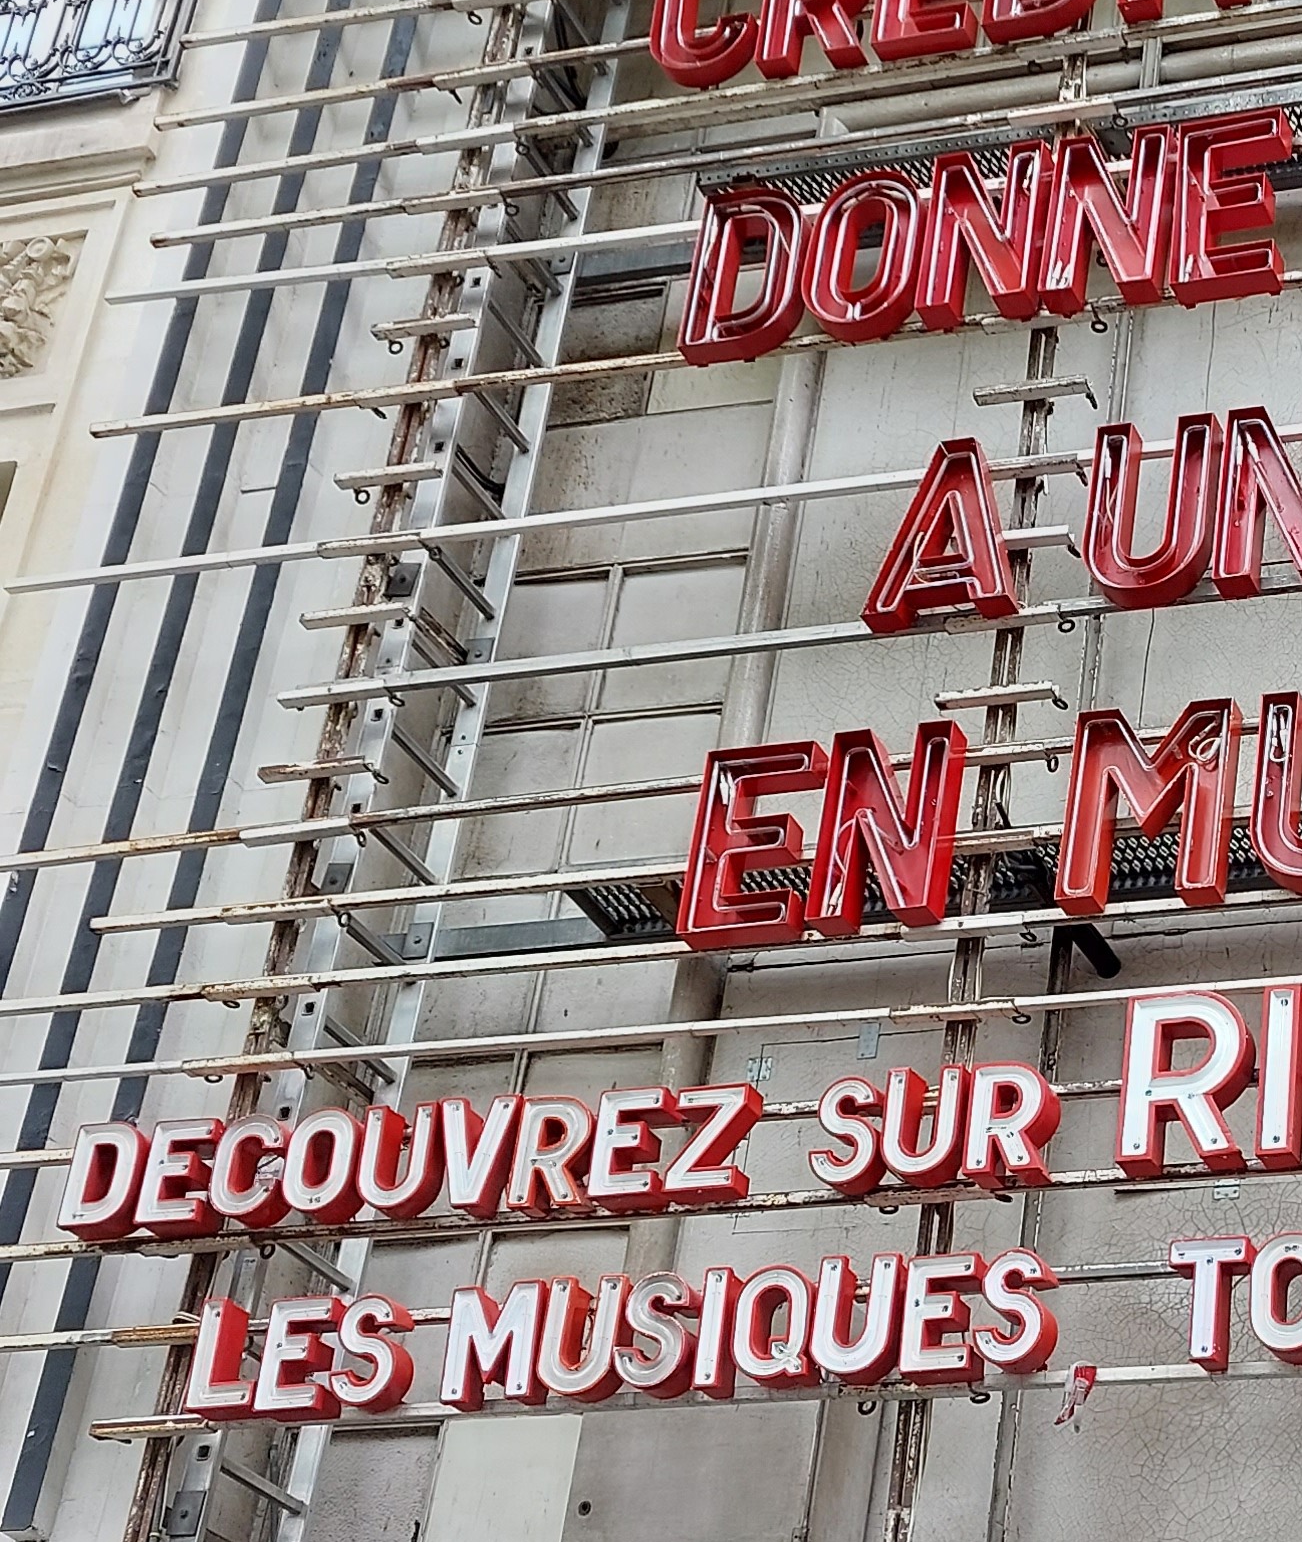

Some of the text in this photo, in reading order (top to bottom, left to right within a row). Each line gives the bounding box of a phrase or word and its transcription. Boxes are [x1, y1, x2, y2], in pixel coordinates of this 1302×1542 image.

[677, 107, 1292, 367] DONNE
[860, 437, 1019, 634] A
[675, 719, 968, 951] EN
[56, 1081, 763, 1242] DECOUVREZ
[808, 1062, 1062, 1197] SUR
[185, 1291, 415, 1421] LES
